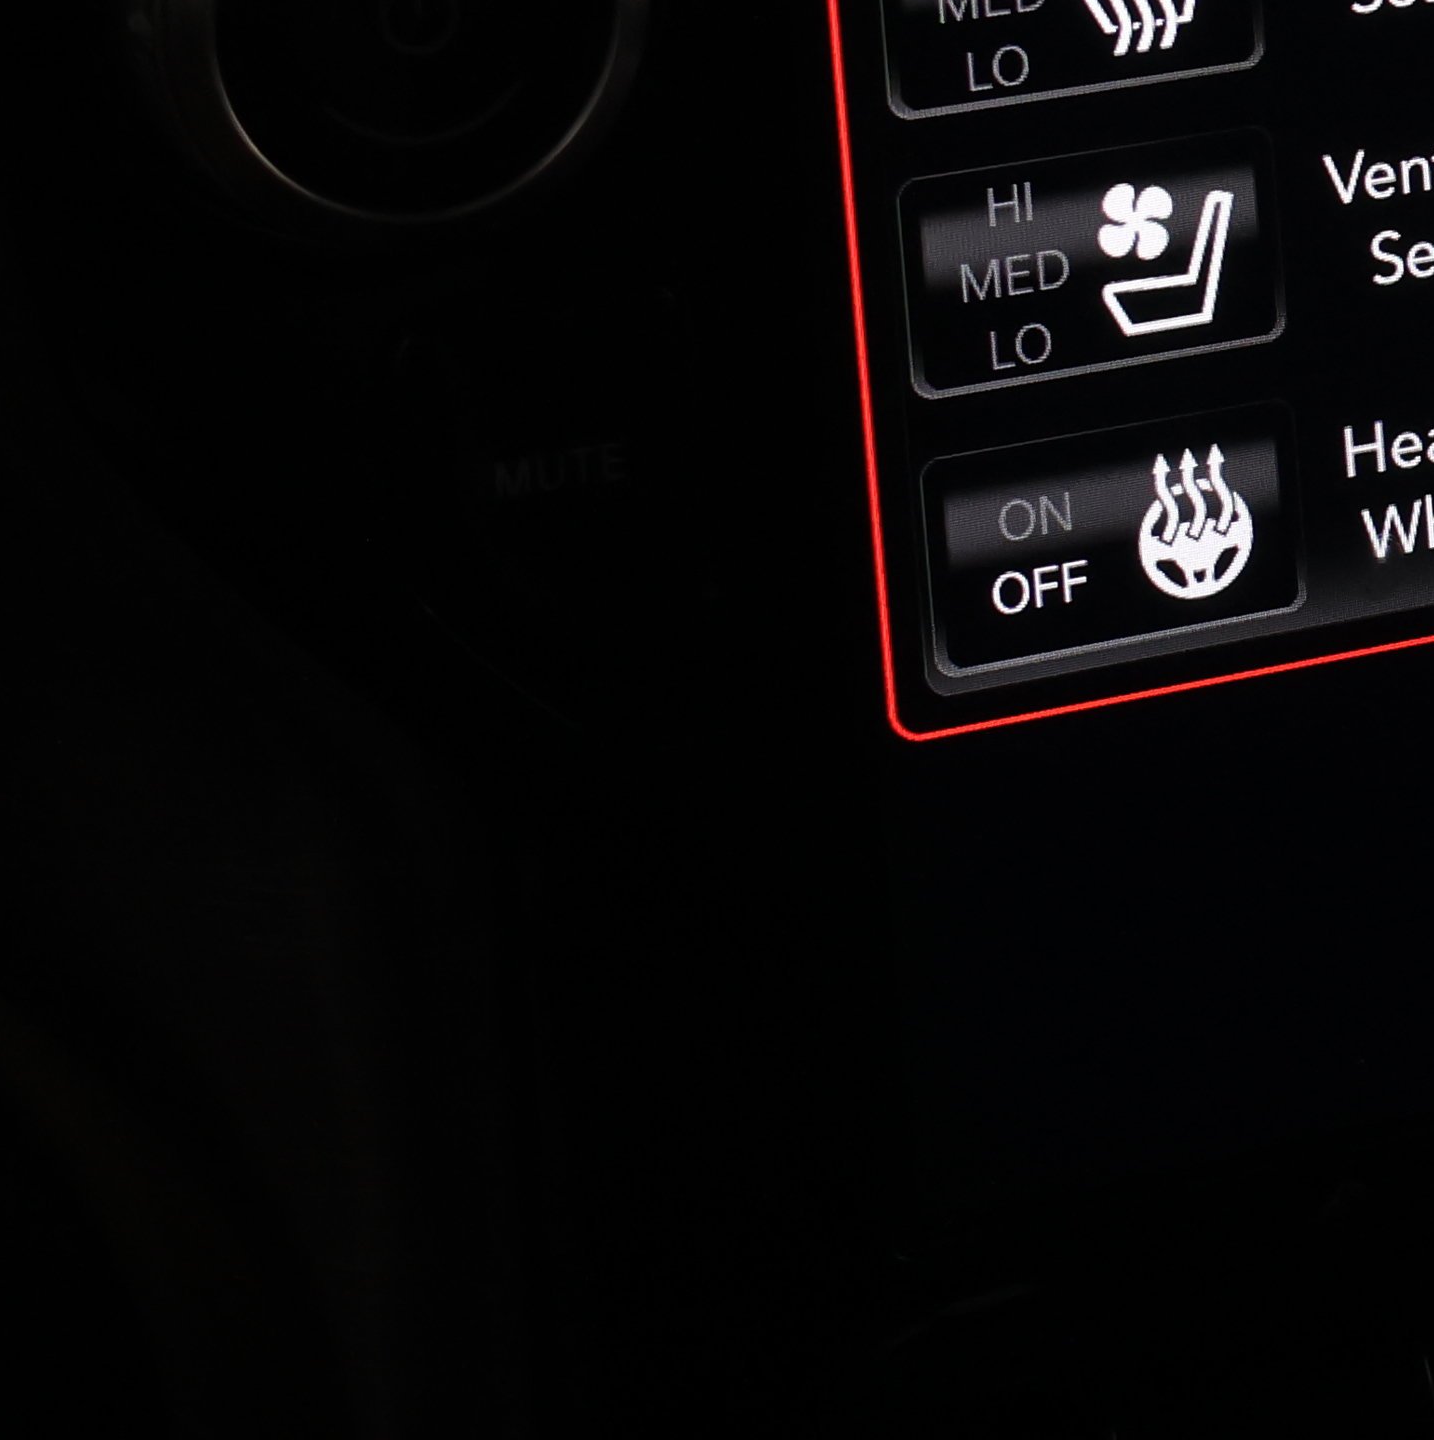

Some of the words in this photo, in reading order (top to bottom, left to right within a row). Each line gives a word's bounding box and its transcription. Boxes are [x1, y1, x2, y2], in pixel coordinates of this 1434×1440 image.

[967, 45, 1029, 92] LO
[987, 182, 1033, 228] HI
[959, 249, 1071, 305] MED
[990, 323, 1051, 370] LO
[494, 442, 627, 497] MUTE
[998, 491, 1072, 541] ON
[992, 560, 1087, 614] OFF
